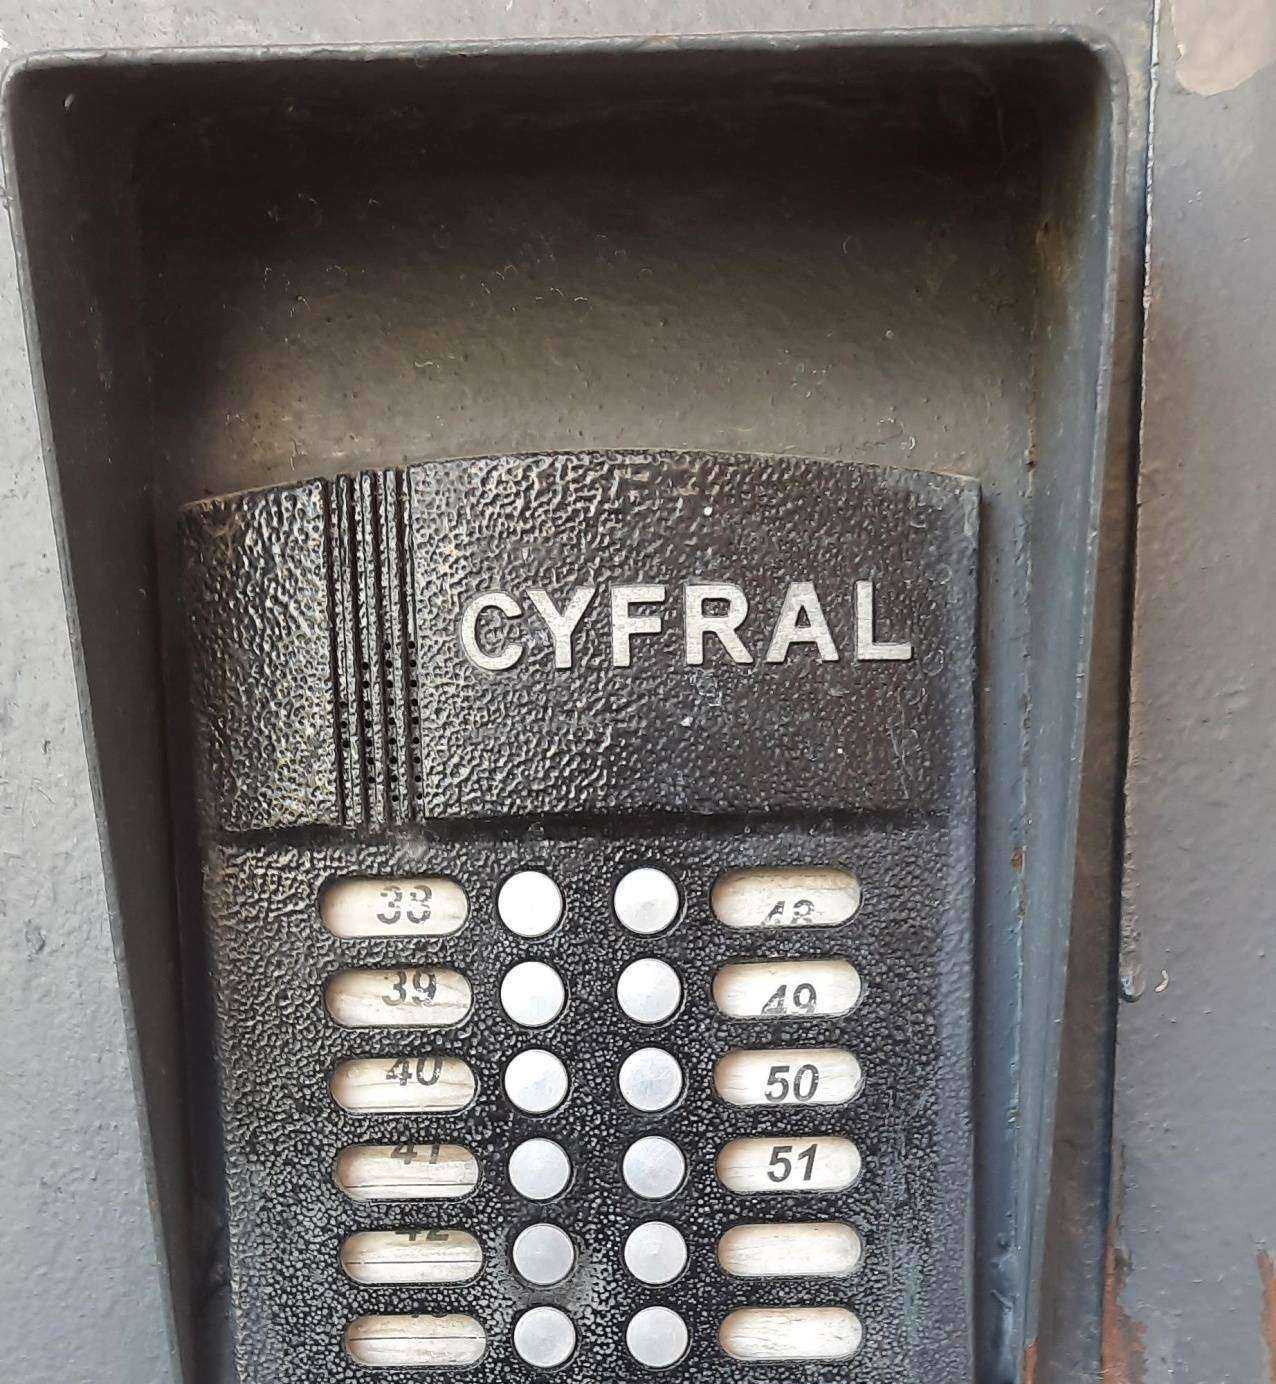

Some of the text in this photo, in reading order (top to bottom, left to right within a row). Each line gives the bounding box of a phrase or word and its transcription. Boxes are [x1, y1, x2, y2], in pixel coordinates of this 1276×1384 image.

[460, 580, 914, 671] CYFRAL
[382, 970, 437, 1006] 39
[764, 1063, 820, 1102] 50
[767, 1144, 818, 1182] 51
